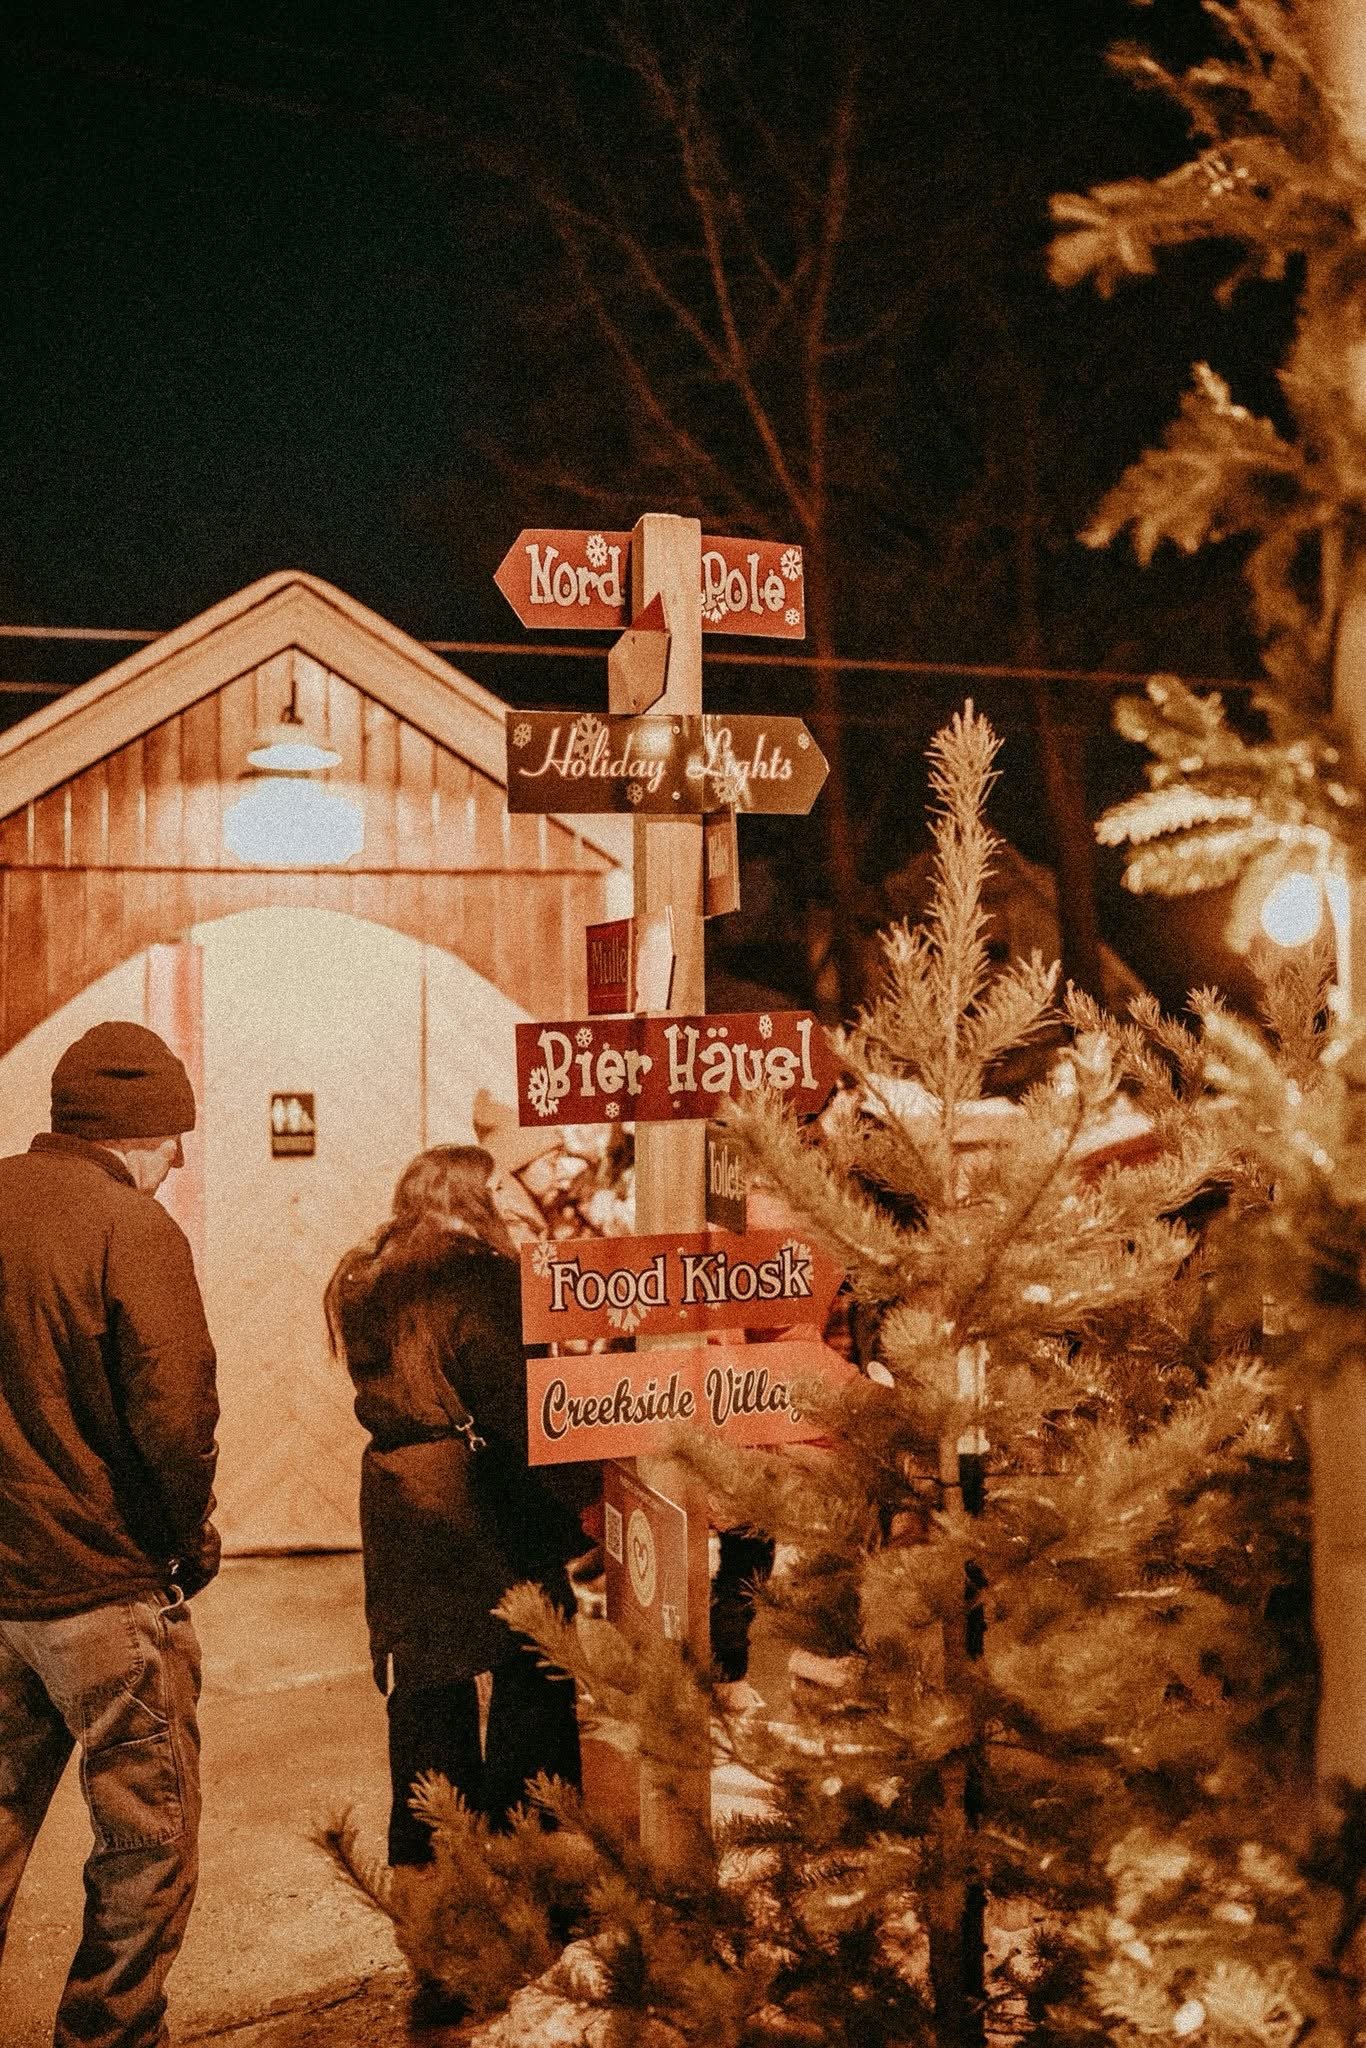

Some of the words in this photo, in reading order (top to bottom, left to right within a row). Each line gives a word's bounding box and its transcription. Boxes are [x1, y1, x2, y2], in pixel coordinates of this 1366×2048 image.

[525, 543, 626, 608] Nord
[702, 550, 786, 616] Pole
[518, 726, 667, 794] Holiday
[685, 727, 793, 793] Lights
[537, 1029, 653, 1099] Bier
[664, 1017, 819, 1094] Häusl
[548, 1253, 668, 1312] Food
[680, 1246, 813, 1307] Kiosk
[542, 1371, 696, 1440] Creekside
[705, 1365, 802, 1428] Villa
